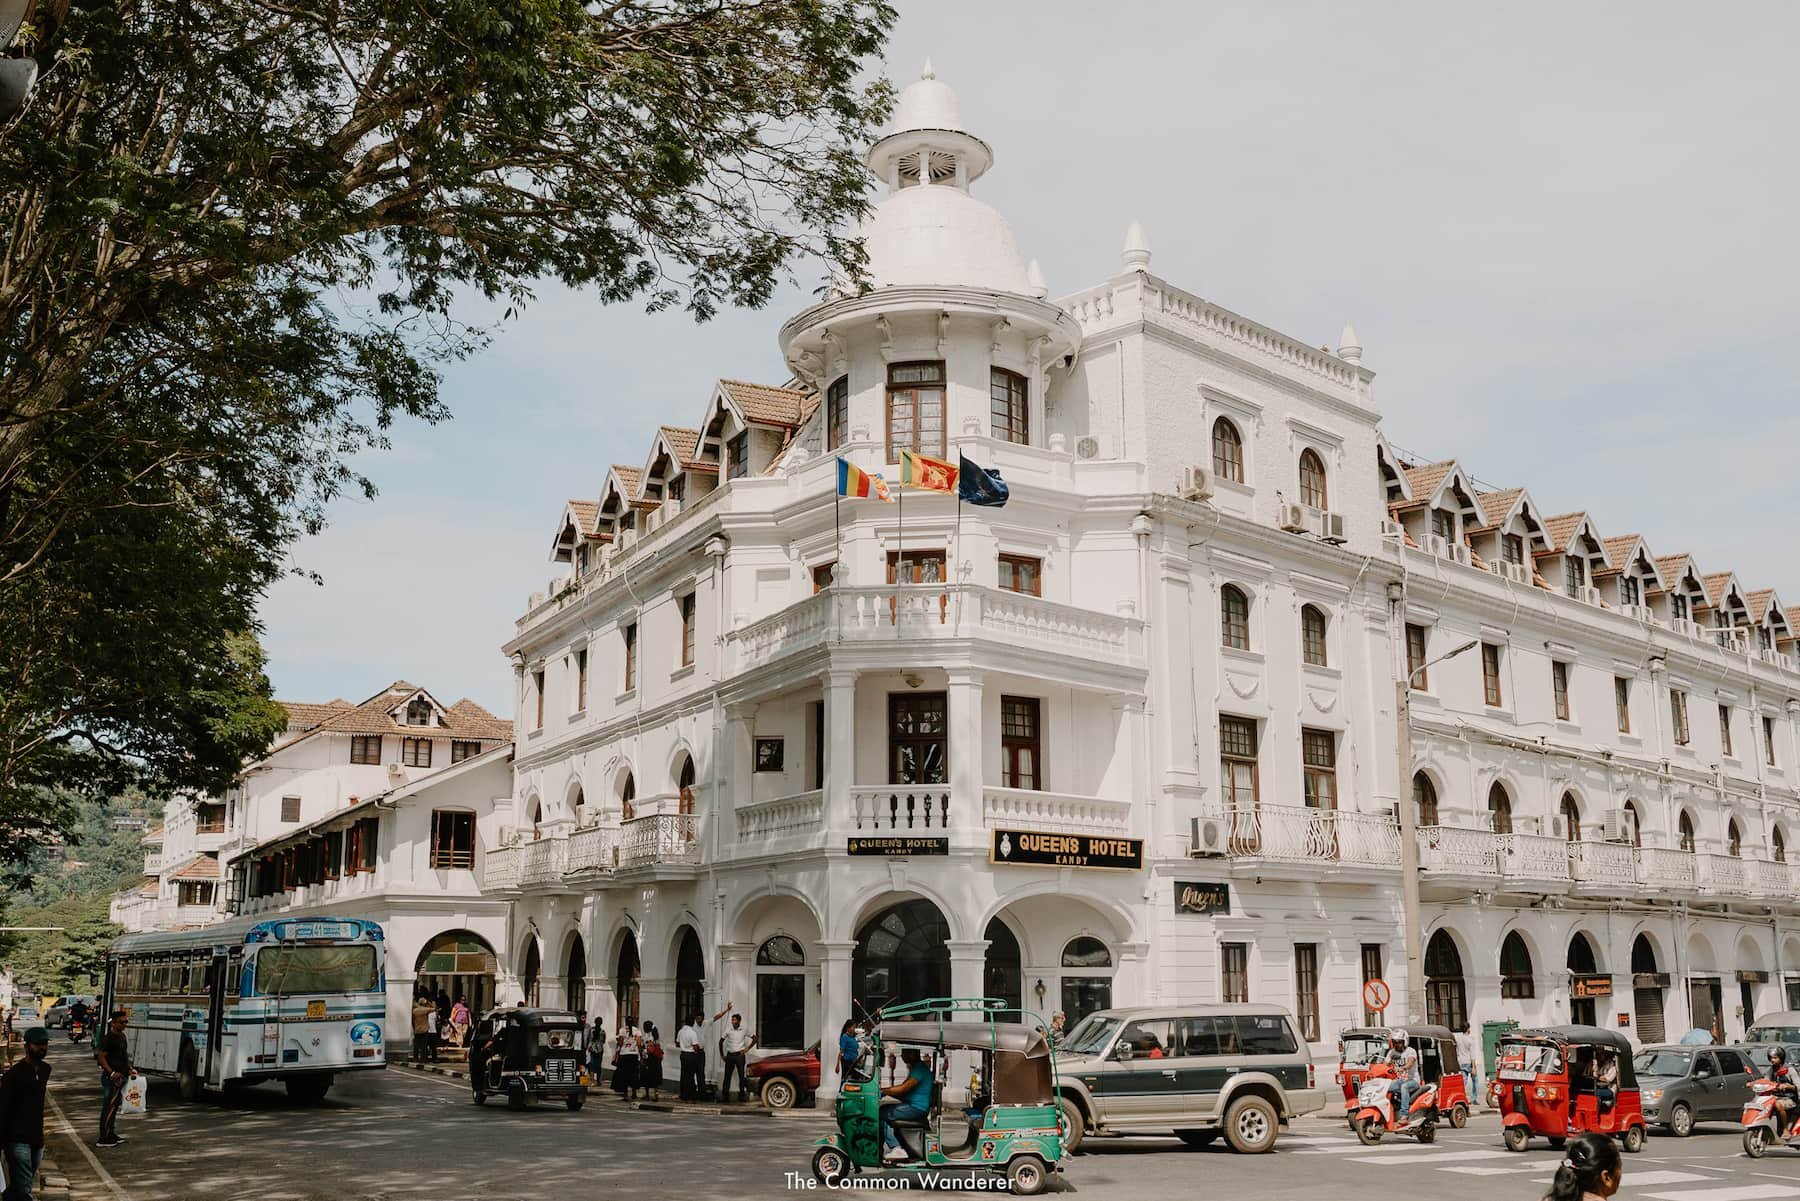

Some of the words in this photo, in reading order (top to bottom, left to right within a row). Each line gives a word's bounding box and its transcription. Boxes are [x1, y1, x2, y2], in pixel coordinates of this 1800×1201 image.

[1089, 839, 1136, 857] HOTEL
[1055, 854, 1088, 865] KANDY
[1181, 886, 1224, 911] Queen's
